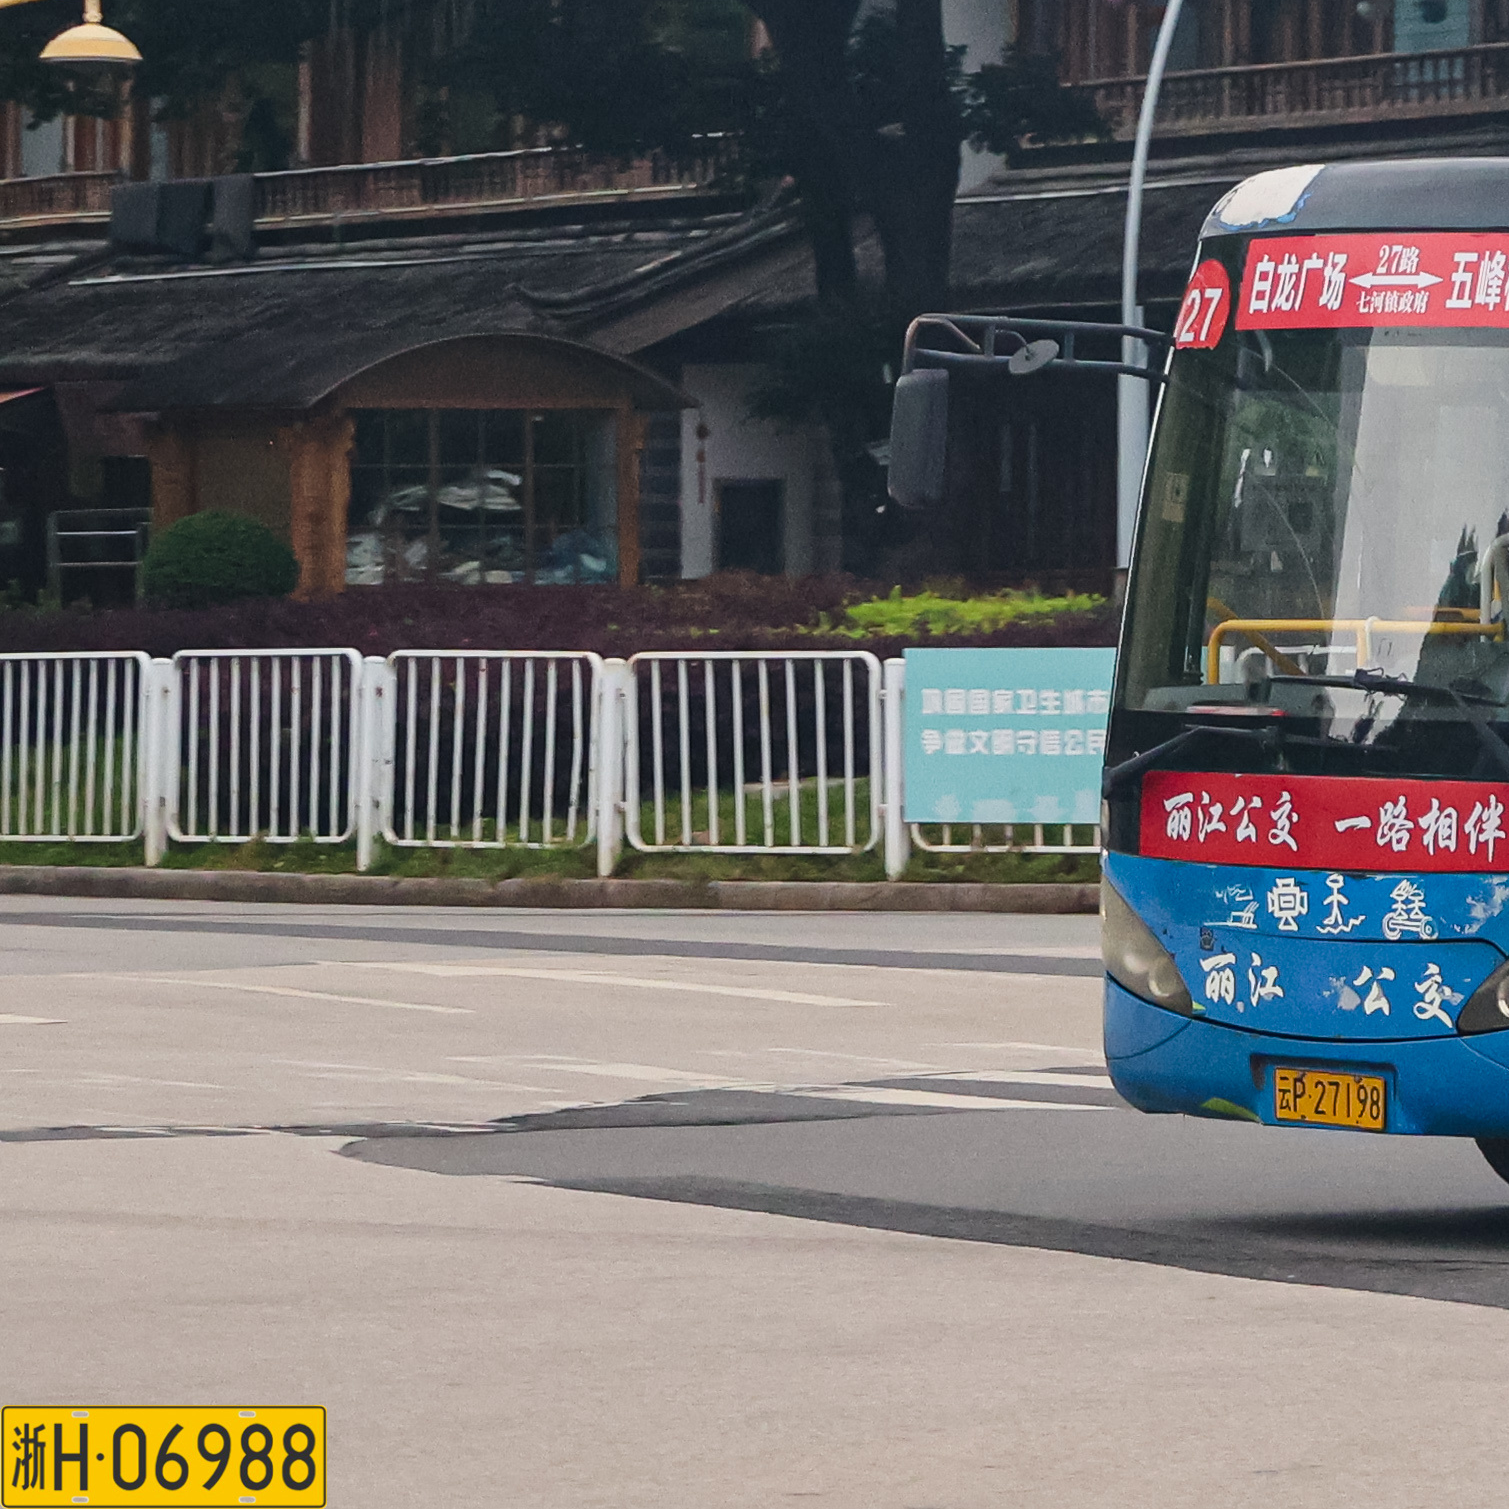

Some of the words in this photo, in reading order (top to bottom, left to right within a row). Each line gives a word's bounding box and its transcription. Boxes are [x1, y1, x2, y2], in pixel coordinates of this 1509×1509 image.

[1249, 251, 1348, 314] 白龙广场
[1377, 245, 1419, 273] 27路
[1179, 288, 1223, 343] 27
[1357, 291, 1428, 314] 七河镇政府
[1162, 790, 1299, 852] 丽江公交
[1335, 793, 1507, 862] 一路相伴
[1201, 952, 1284, 1007] 丽江
[1353, 963, 1454, 1028] 公交
